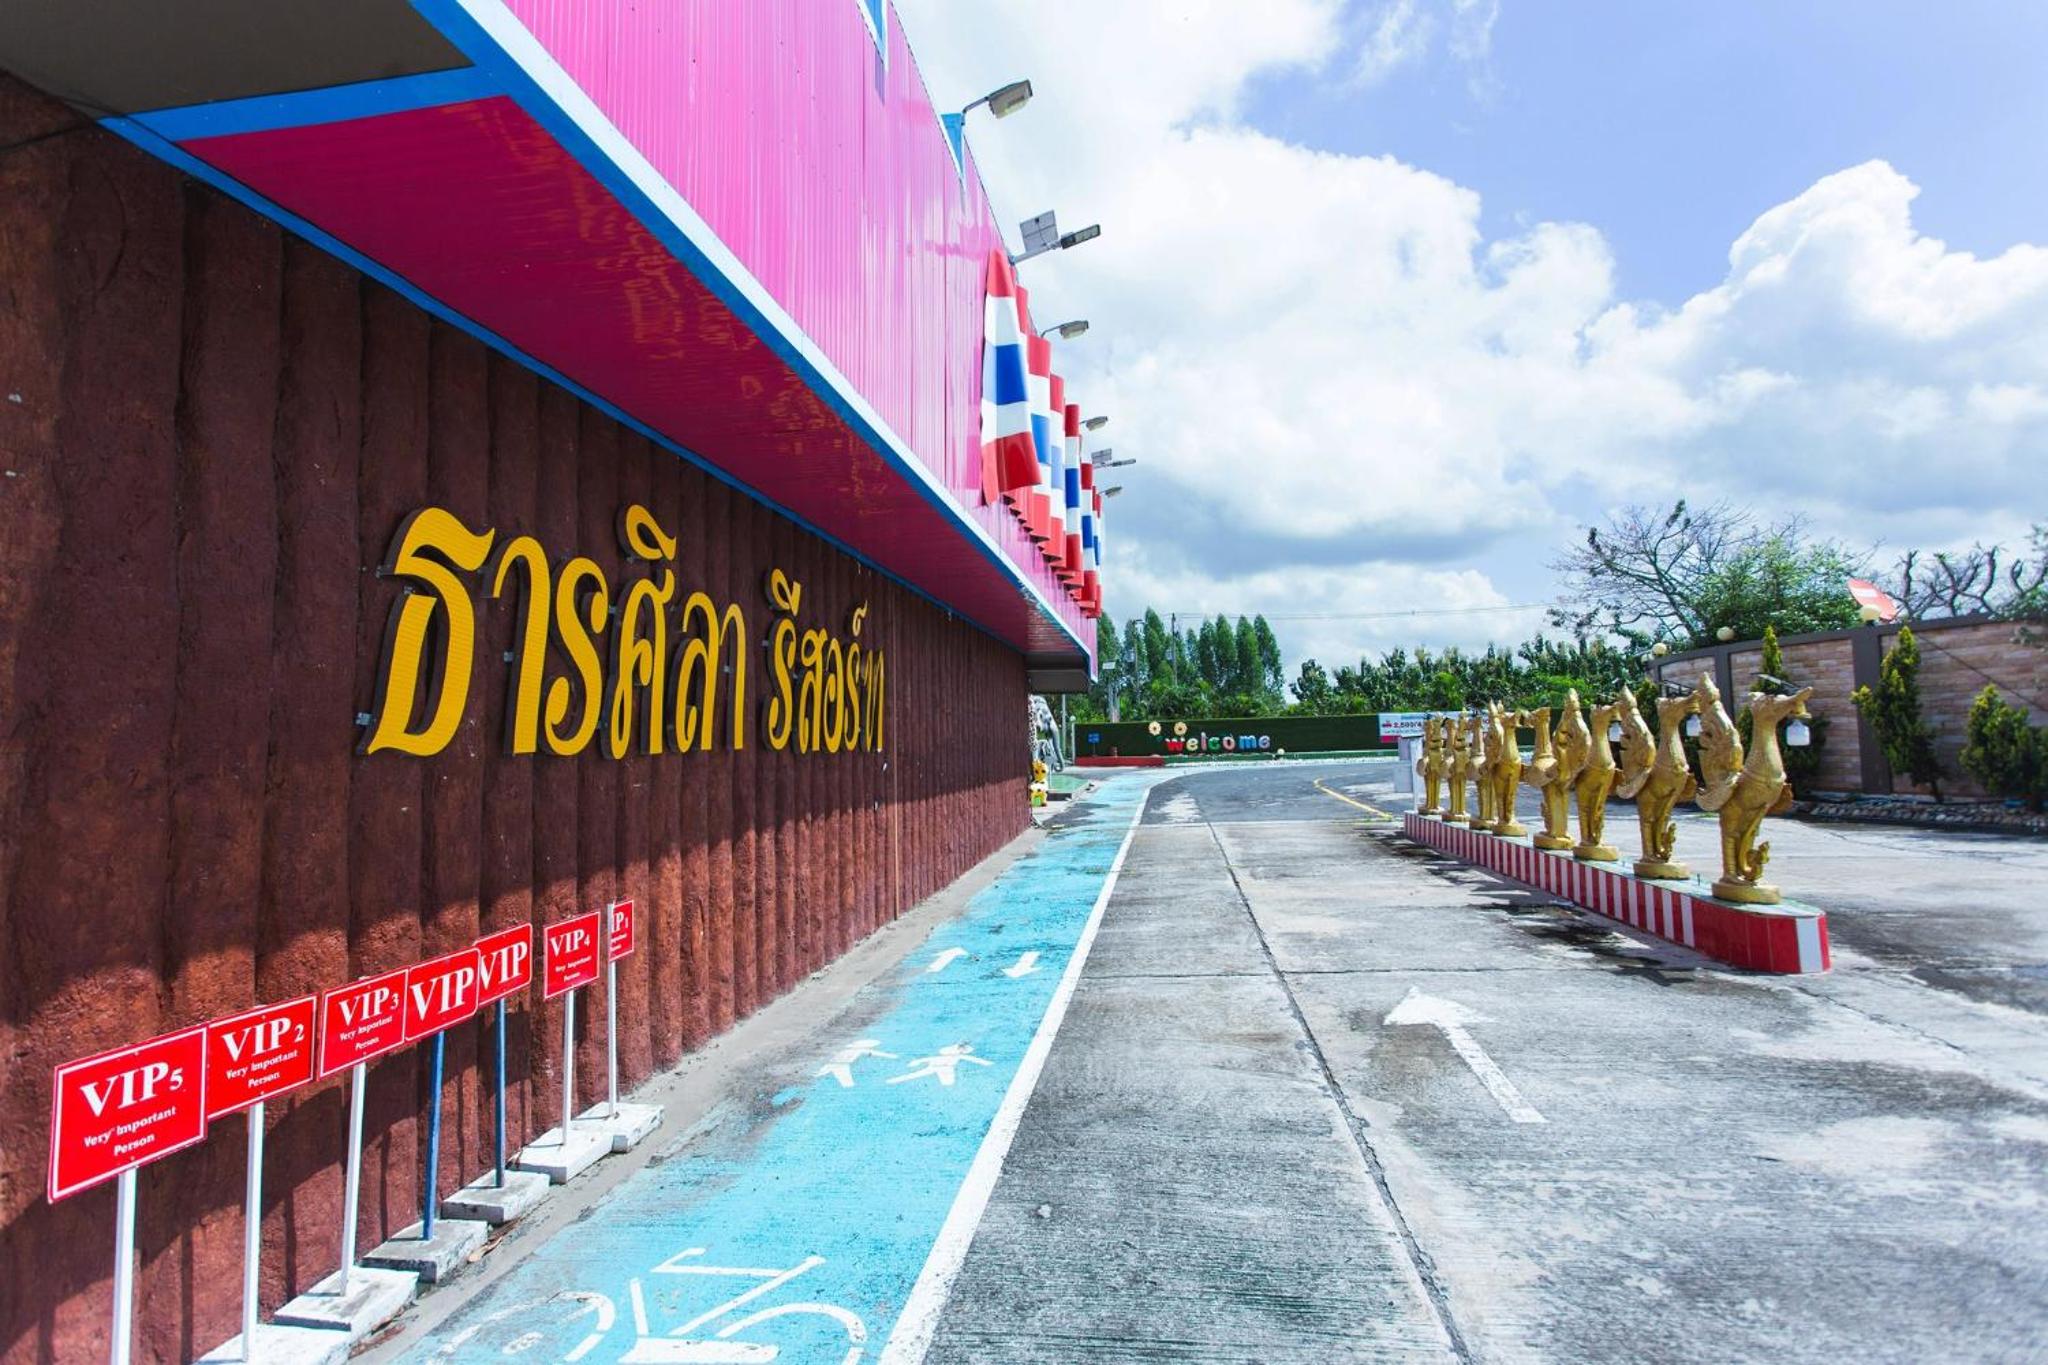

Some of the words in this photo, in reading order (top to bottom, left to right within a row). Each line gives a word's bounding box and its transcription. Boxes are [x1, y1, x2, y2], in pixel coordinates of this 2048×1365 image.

[768, 567, 885, 755] รีสอร์ท
[1165, 731, 1270, 752] welcome
[480, 941, 528, 990] VIP
[409, 967, 474, 1021] VIP
[226, 1067, 248, 1081] Very
[251, 1050, 298, 1072] Important
[248, 1072, 280, 1088] Person
[84, 1127, 115, 1147] Very
[116, 1106, 177, 1136] Important
[113, 1134, 155, 1156] Person
